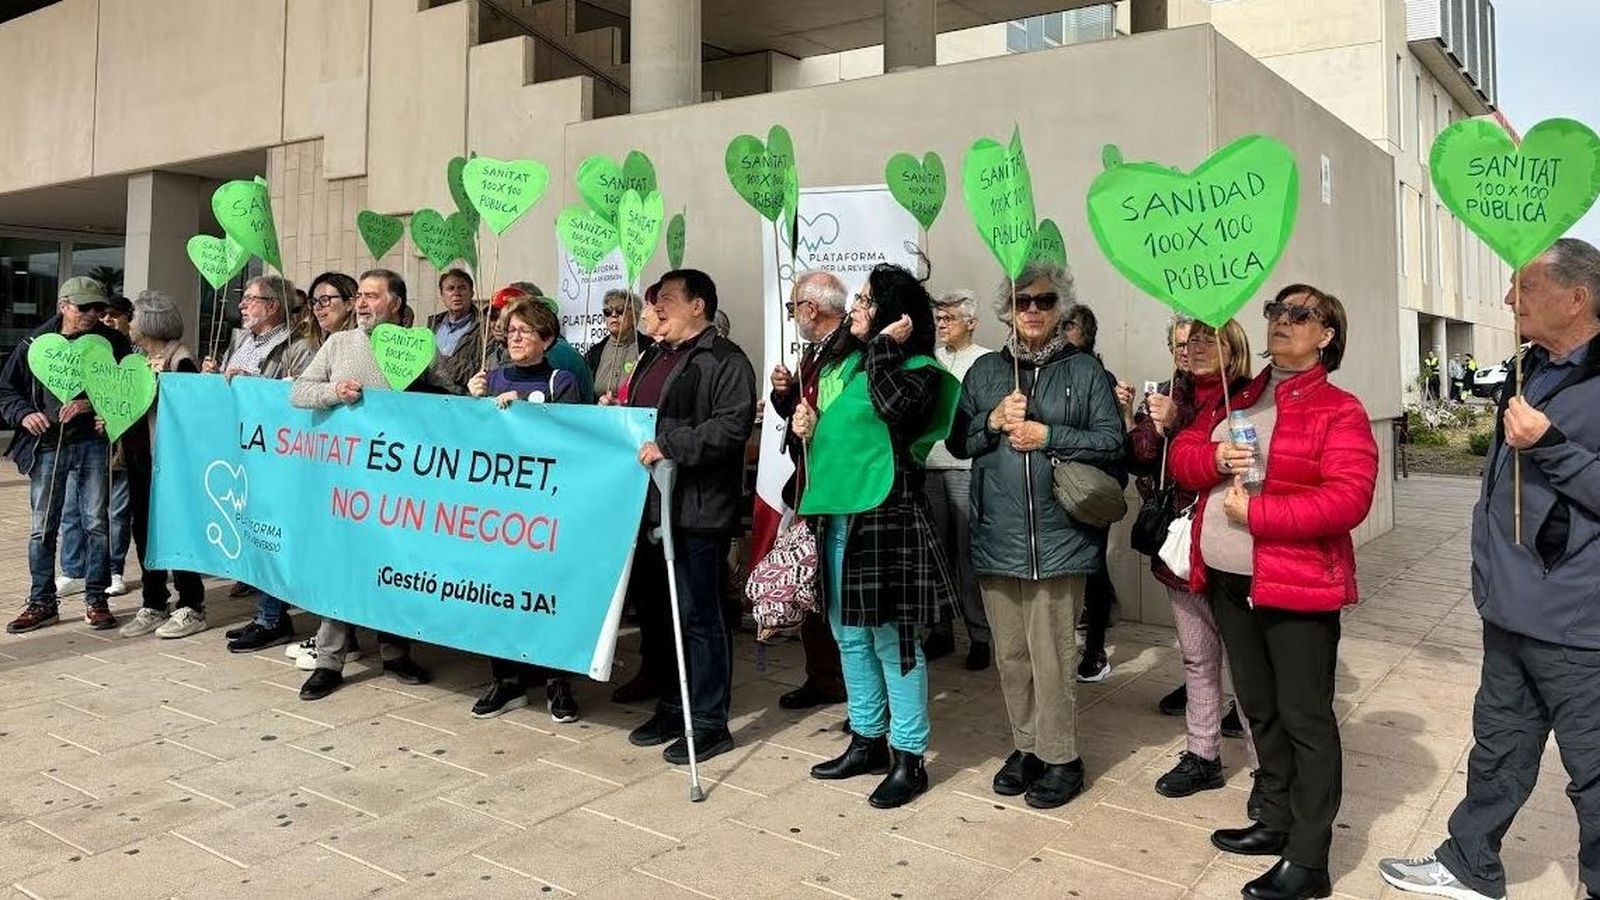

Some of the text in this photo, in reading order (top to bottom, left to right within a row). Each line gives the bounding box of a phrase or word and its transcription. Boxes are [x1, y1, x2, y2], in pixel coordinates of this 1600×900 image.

[483, 165, 531, 184] SANITAT
[599, 173, 648, 192] SANITAT
[1467, 154, 1562, 188] SANITAT
[1122, 171, 1266, 222] SANIDAD
[1466, 198, 1548, 223] PÚBLICA
[809, 251, 886, 263] PLATAFORMA
[1164, 251, 1265, 295] PÚBLICA
[562, 313, 604, 327] PLATAFO
[239, 421, 558, 498] LA SANITAT ÉS UN DRET,
[332, 486, 559, 553] NO UN NEGOCI
[377, 565, 557, 616] ¡Gestió pública JA!
